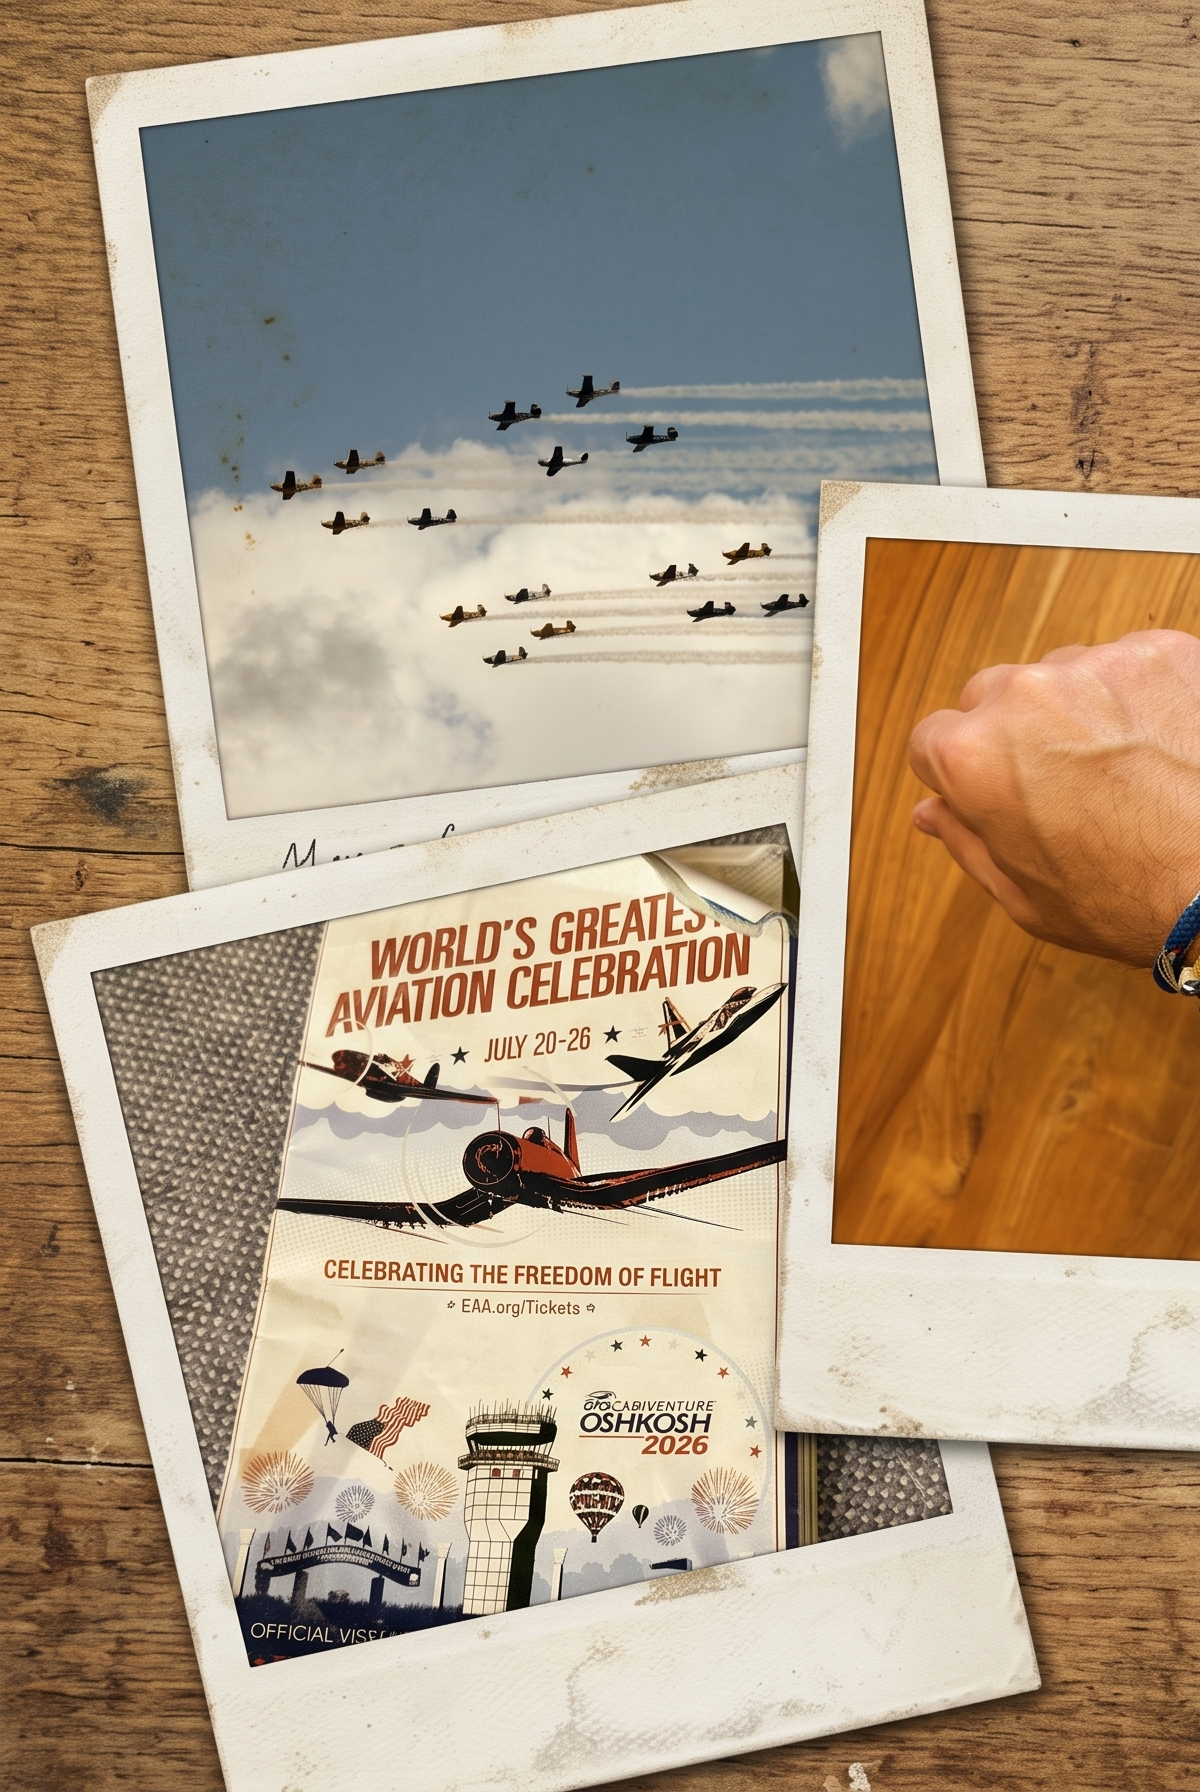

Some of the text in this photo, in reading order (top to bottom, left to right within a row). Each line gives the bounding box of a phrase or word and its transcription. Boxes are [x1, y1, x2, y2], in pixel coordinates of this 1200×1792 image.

[371, 892, 720, 980] WORLD'S GREATES
[325, 932, 750, 1037] AVIATION CELEBRATION
[484, 1026, 592, 1063] JULY 20-26
[324, 1259, 722, 1288] CELEBRATING THE FREEDOM OF FLIGHT
[461, 1298, 581, 1318] EAA.org/Tickets
[580, 1412, 712, 1434] OSHKOSH
[641, 1435, 709, 1455] 2026
[250, 1622, 334, 1643] OFFICIAL
